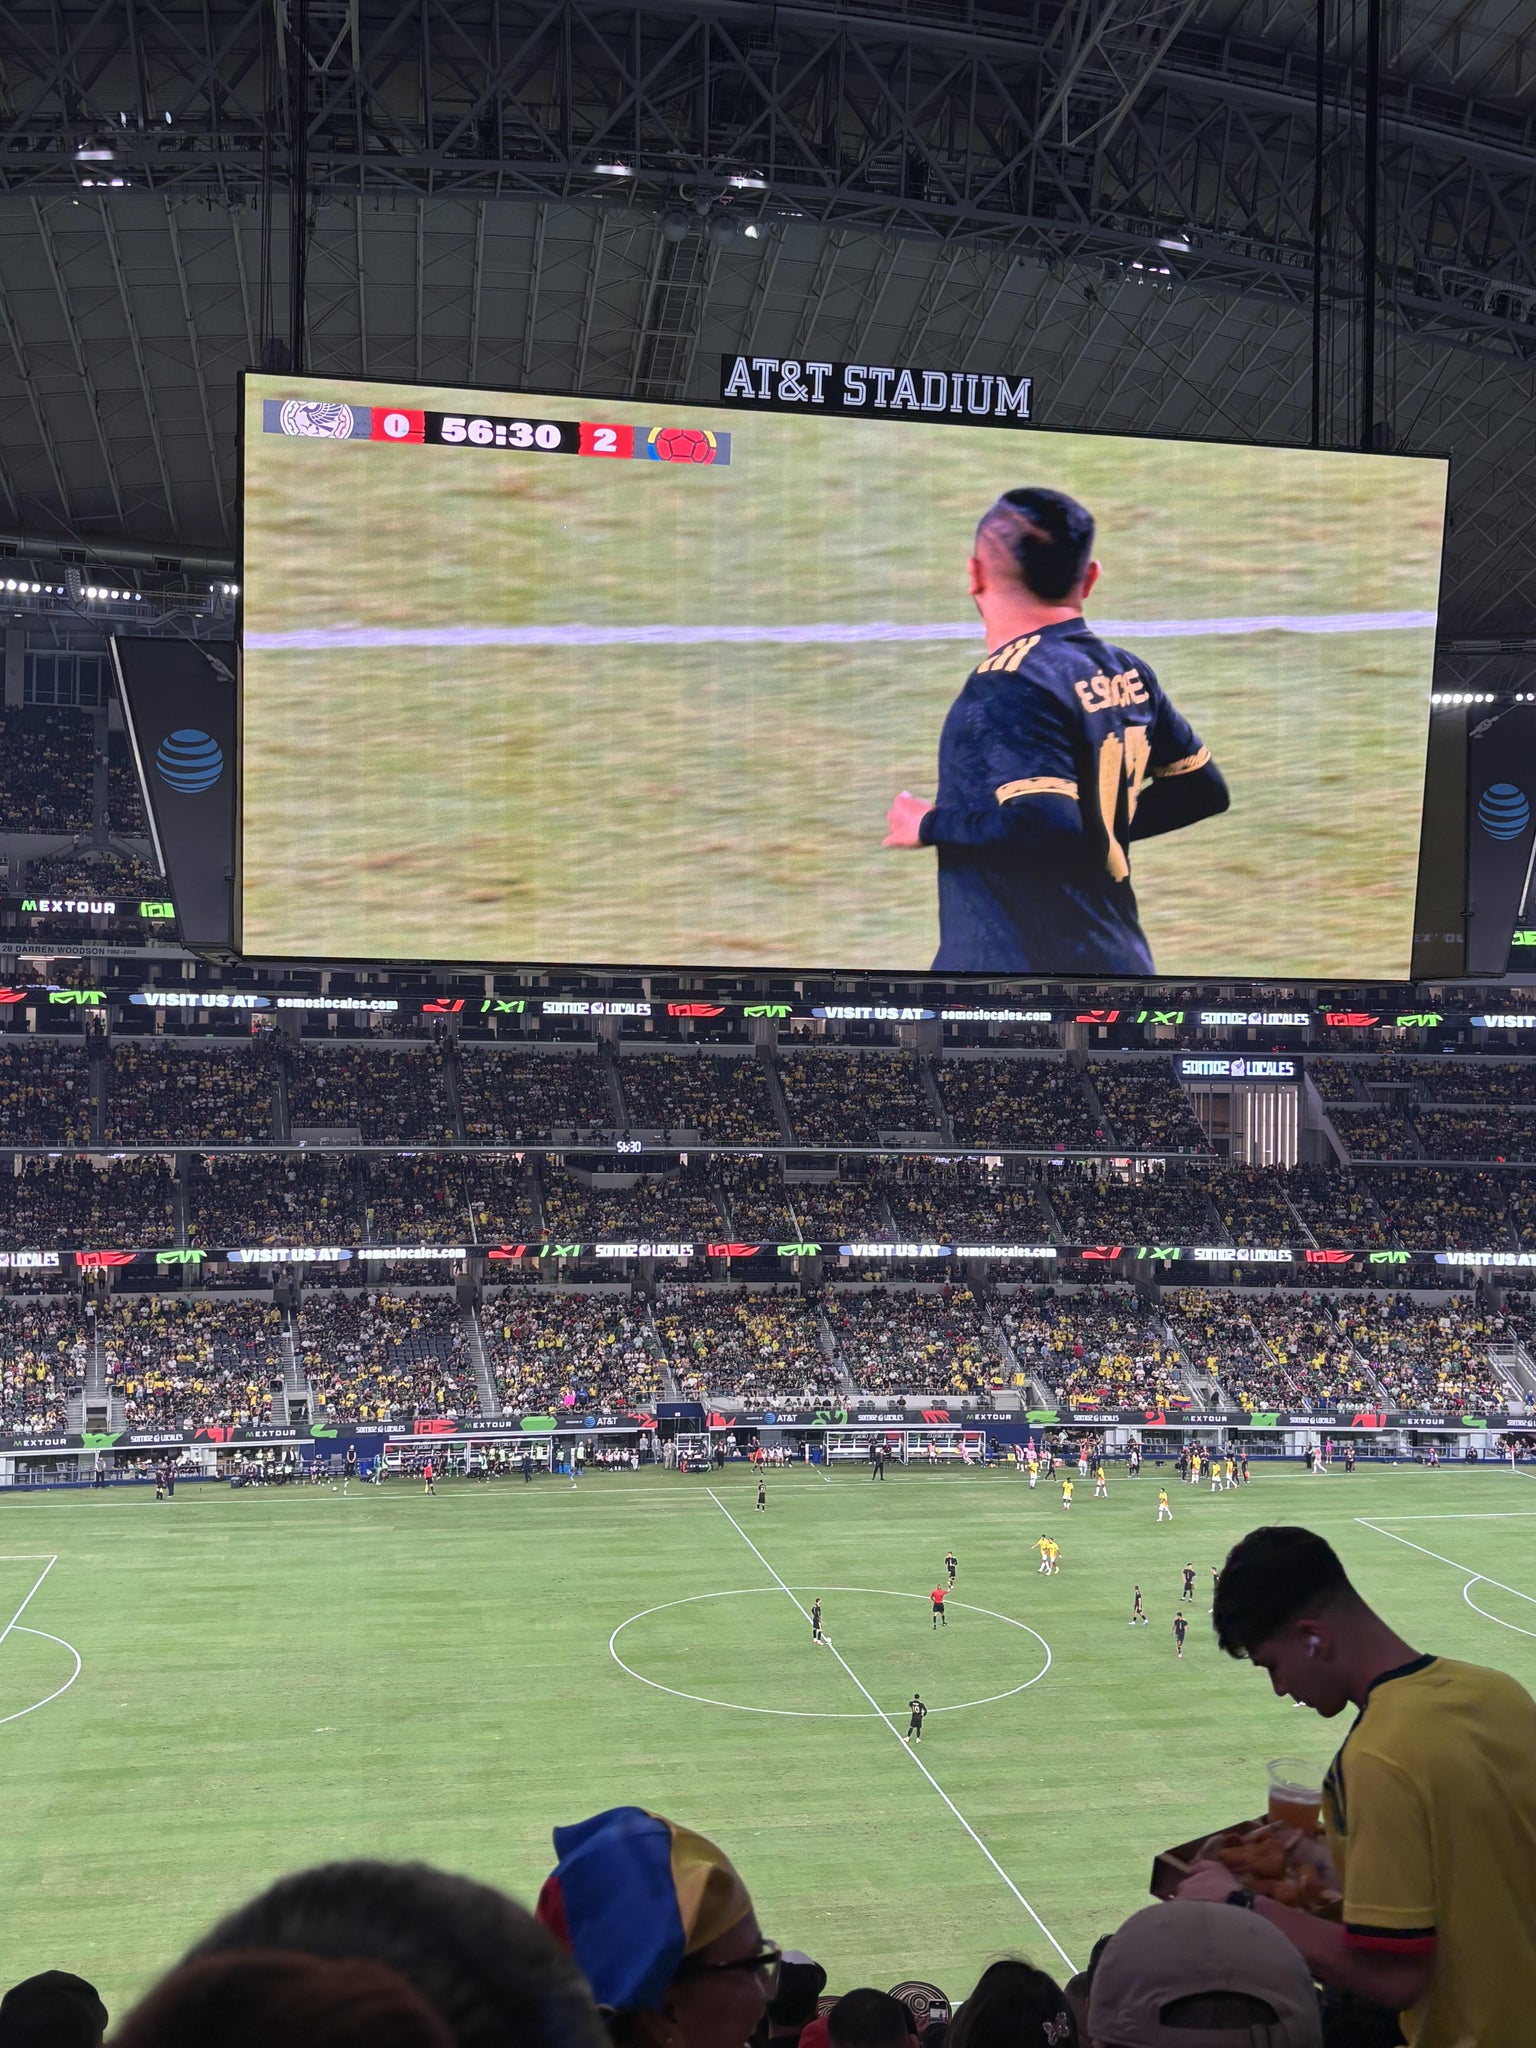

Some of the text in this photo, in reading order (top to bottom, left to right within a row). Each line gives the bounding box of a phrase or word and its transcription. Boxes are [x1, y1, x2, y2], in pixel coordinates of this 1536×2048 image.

[724, 356, 1032, 418] AT&T STADIUM
[383, 413, 410, 438] 0
[441, 417, 562, 449] 56:30
[593, 428, 618, 453] 2
[21, 900, 116, 915] MEXTOUR
[15, 945, 54, 954] DARREN
[57, 946, 105, 955] WOODSON
[143, 992, 258, 1008] VISIT US AT
[605, 1002, 652, 1016] LOCALES
[824, 1006, 924, 1020] VISIT US AT
[1262, 1013, 1310, 1026] LOCALES
[1483, 1014, 1536, 1028] VISIT
[1246, 1061, 1294, 1076] LOCALES
[616, 1140, 642, 1153] 56:30
[240, 1247, 341, 1263] VISIT US AT
[652, 1244, 694, 1257] LOCALES
[850, 1244, 941, 1257] VISIT US AT
[1250, 1249, 1292, 1262] LOCALES
[10, 1252, 60, 1267] LOCALES
[1446, 1252, 1536, 1266] VISIT US AT
[596, 1416, 619, 1426] AT&T
[776, 1414, 798, 1423] AT&T
[966, 1413, 1012, 1421] MEXTOUR
[464, 1421, 512, 1429] MEXTOUR
[245, 1429, 296, 1438] MEXTOUR
[13, 1438, 67, 1447] MEXTOUR
